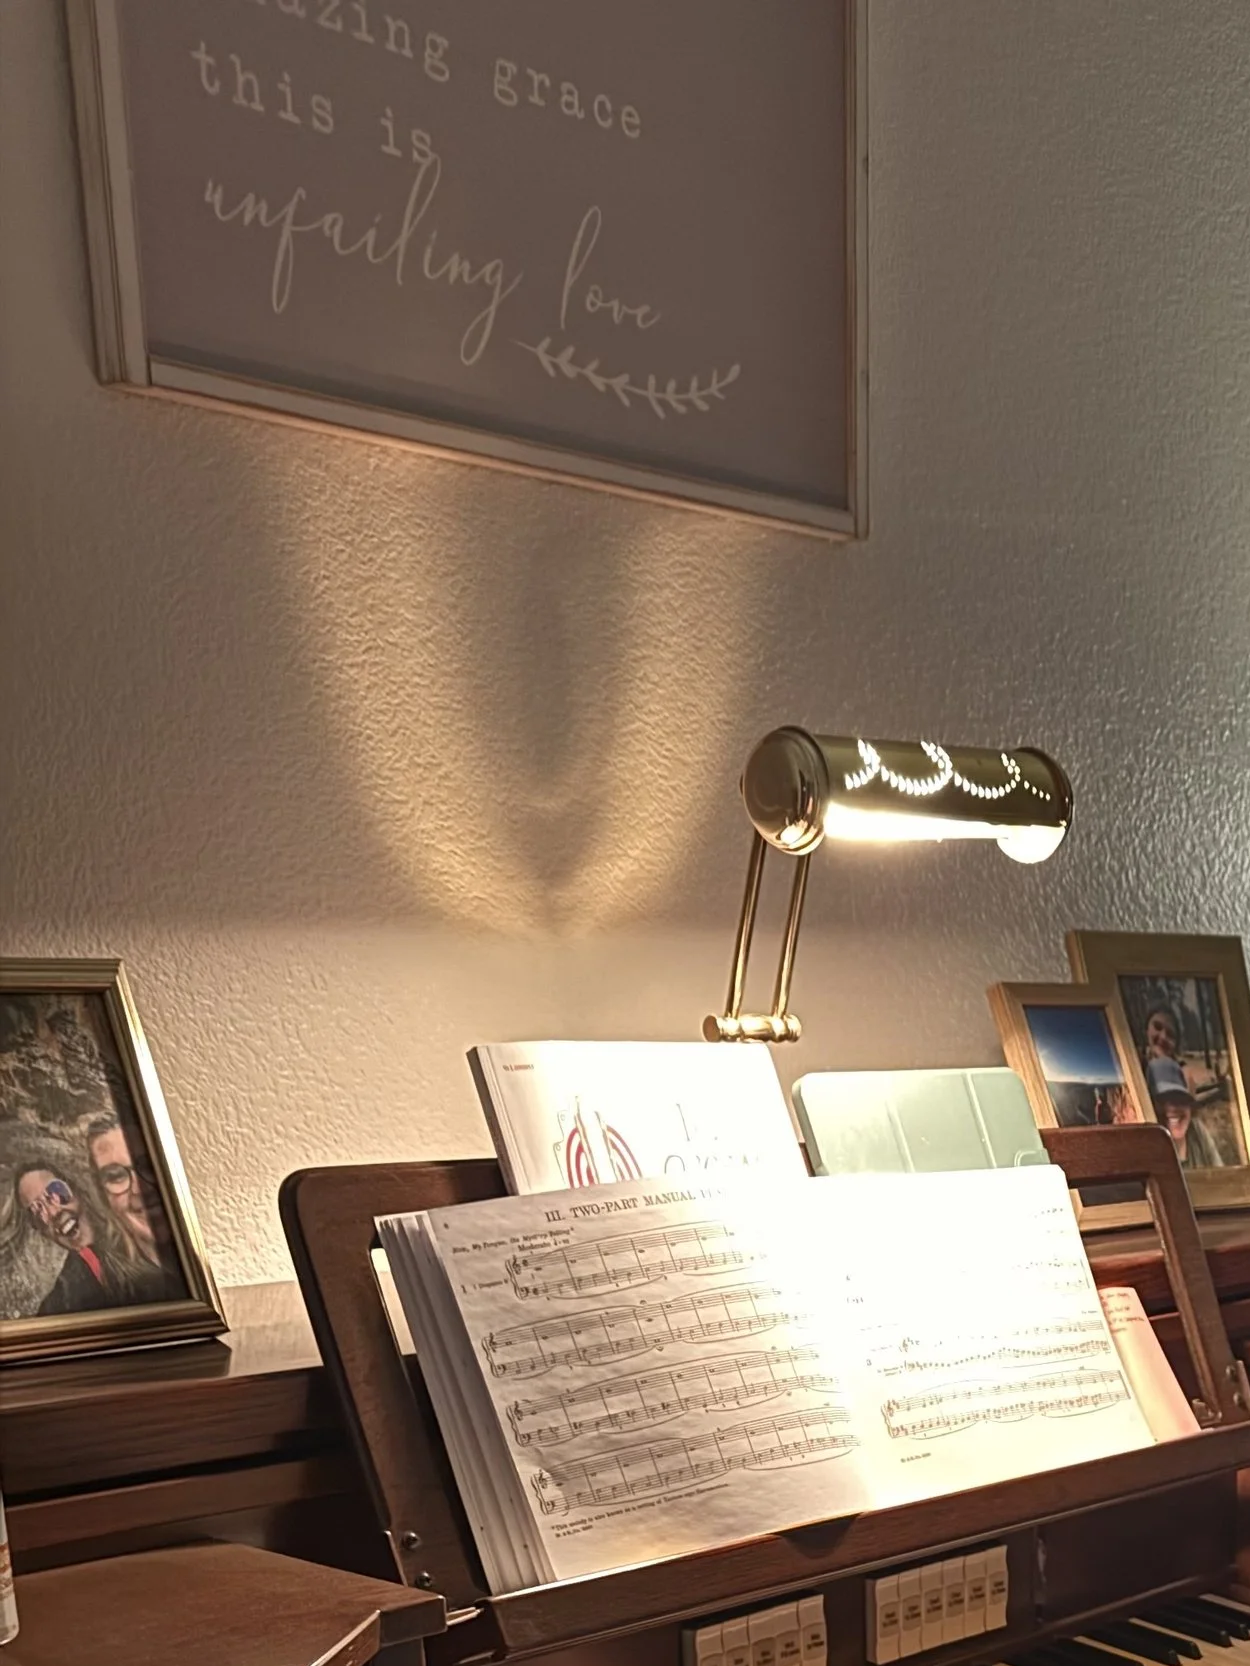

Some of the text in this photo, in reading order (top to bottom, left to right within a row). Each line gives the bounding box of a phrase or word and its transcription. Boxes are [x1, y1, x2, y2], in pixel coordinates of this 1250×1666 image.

[190, 40, 432, 164] this is
[258, 0, 641, 138] azing grace
[204, 154, 662, 366] unfailing love
[569, 1197, 639, 1219] TWO-PART
[642, 1189, 696, 1207] MANUAL
